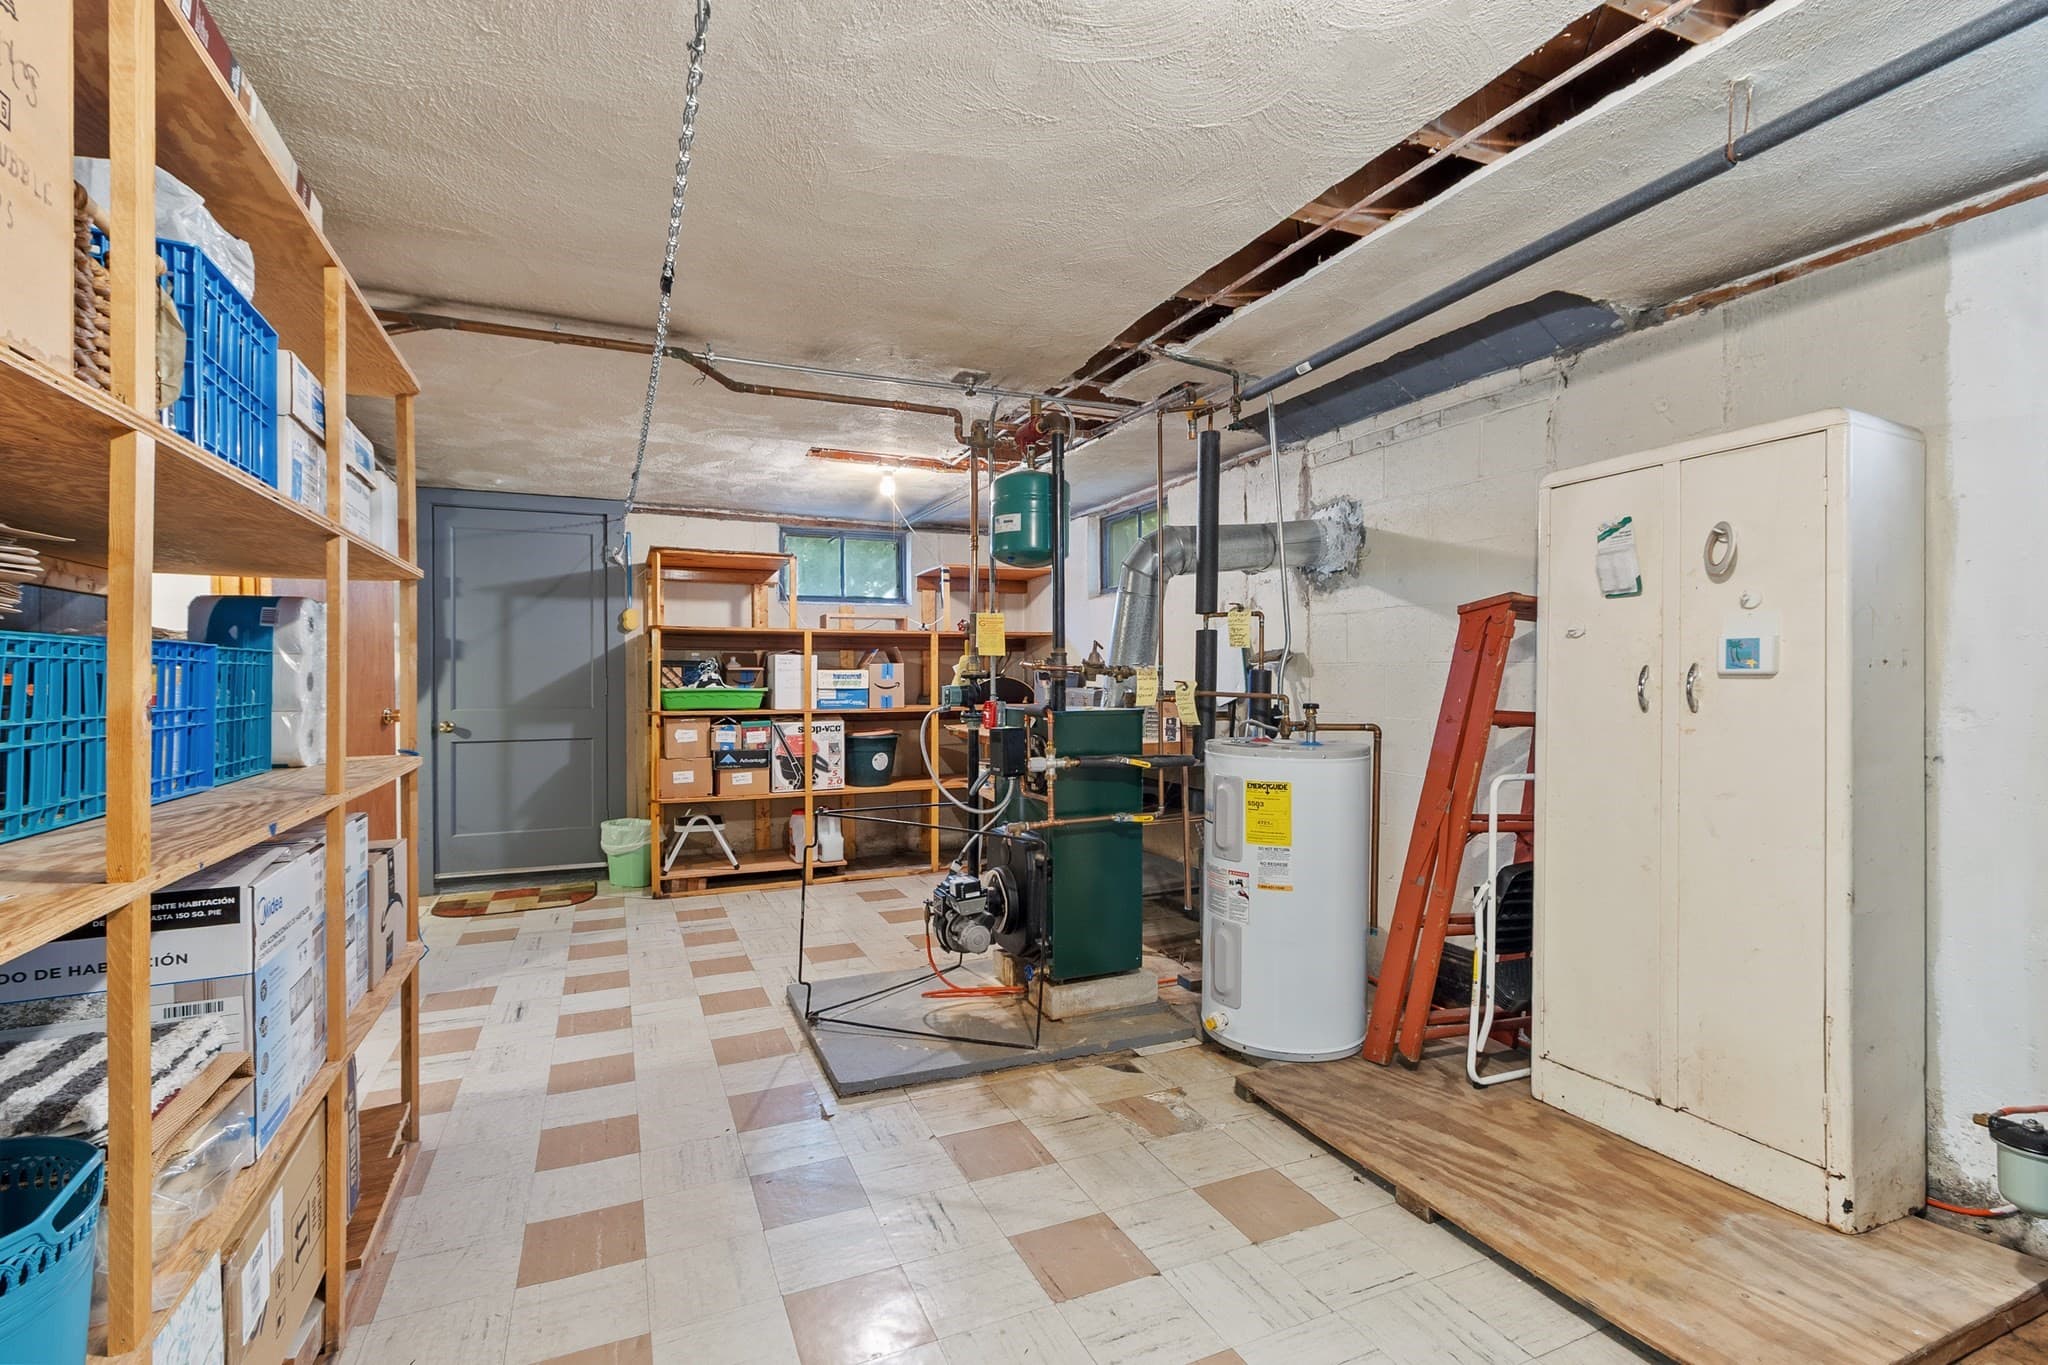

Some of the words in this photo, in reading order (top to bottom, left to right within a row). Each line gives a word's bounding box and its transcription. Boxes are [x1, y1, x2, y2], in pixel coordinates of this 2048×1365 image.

[151, 902, 177, 911] ENTE
[178, 897, 235, 909] HABITACIÓN
[151, 913, 173, 921] ASTA
[175, 911, 190, 919] 150
[207, 909, 222, 917] PIE
[34, 967, 61, 981] DE
